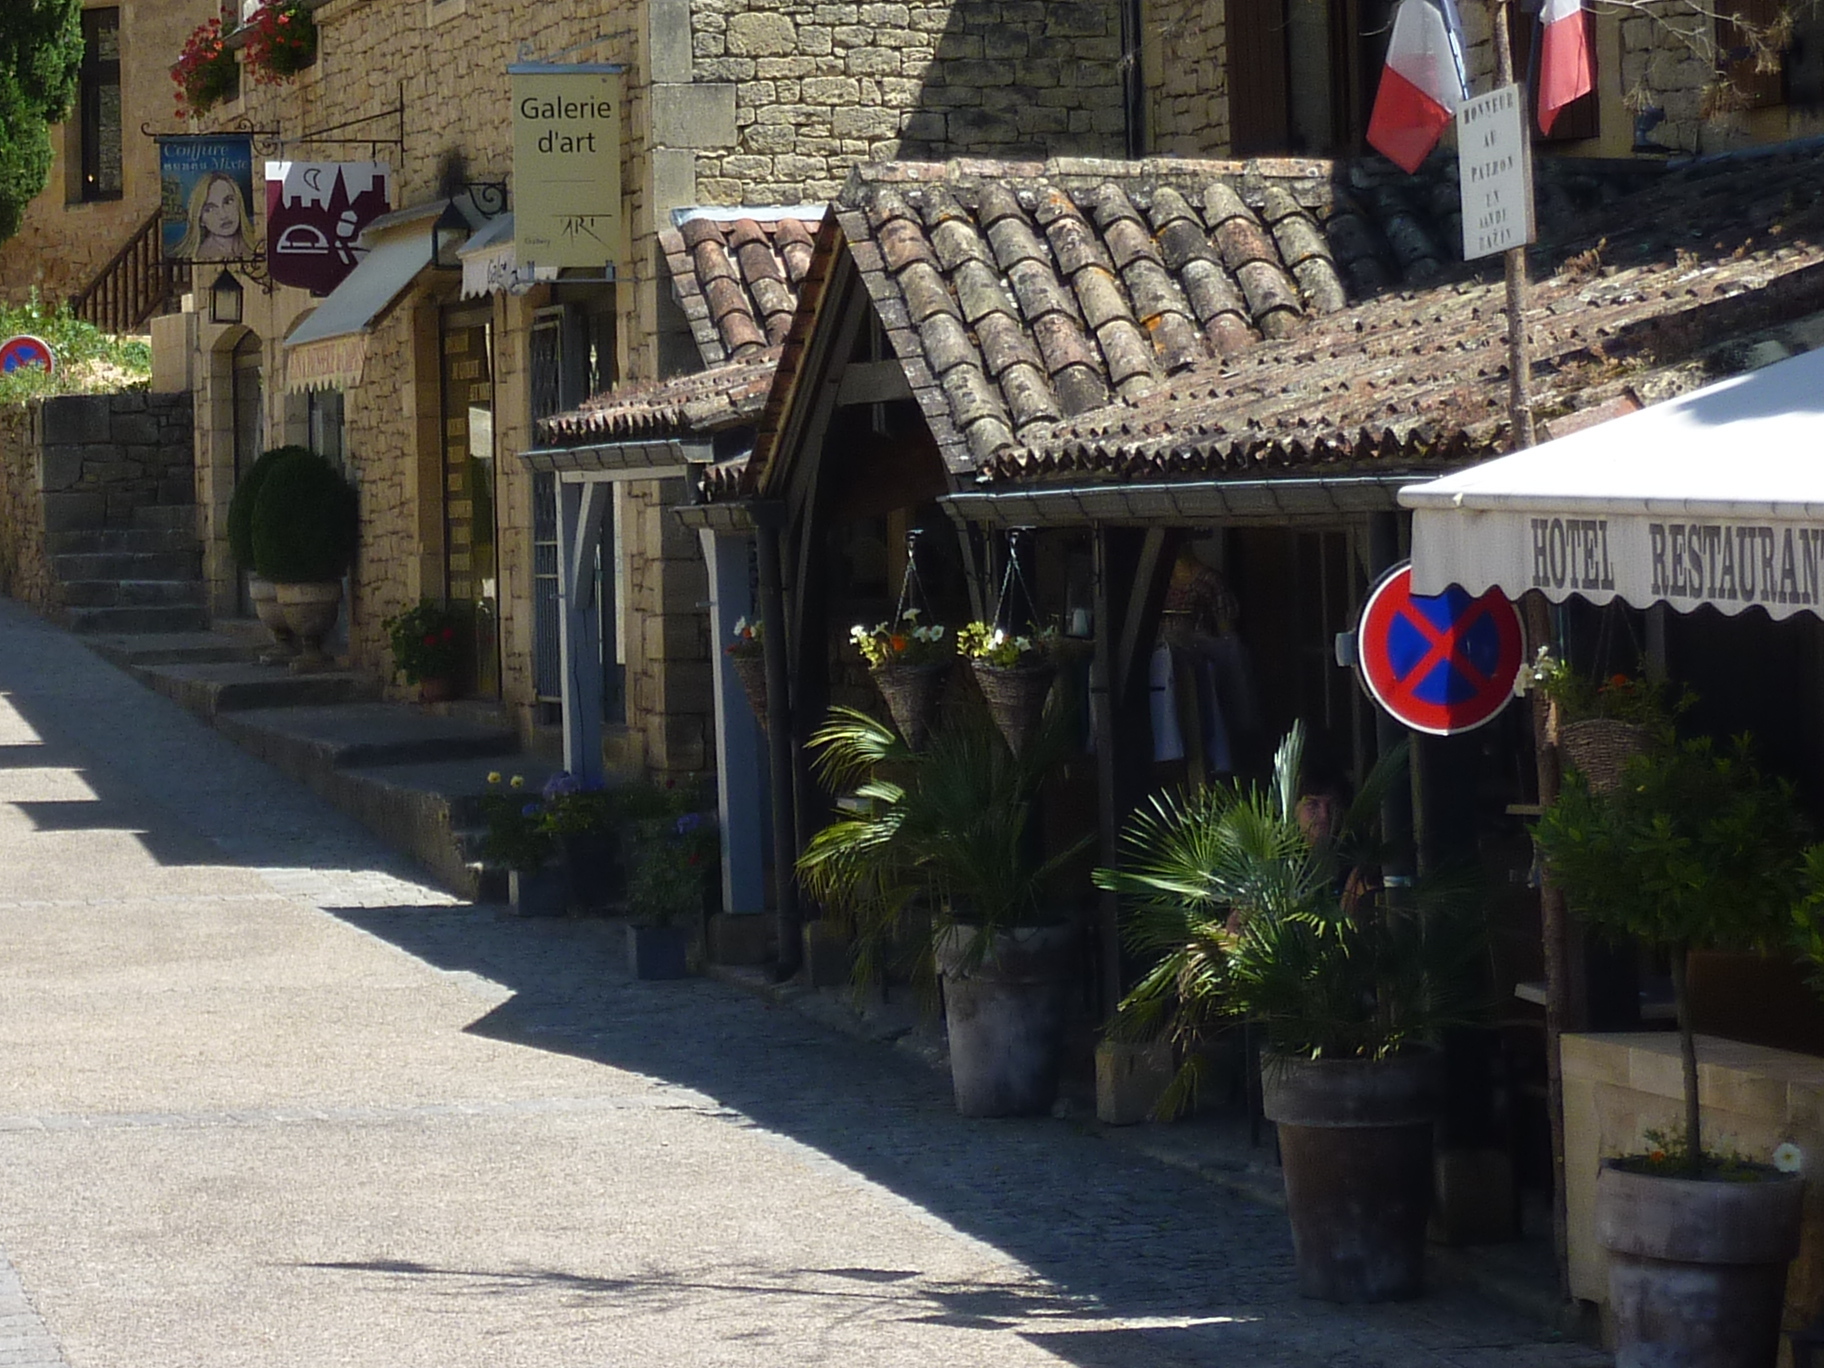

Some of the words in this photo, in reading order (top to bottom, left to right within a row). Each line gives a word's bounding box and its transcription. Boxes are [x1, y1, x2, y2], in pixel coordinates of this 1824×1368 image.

[520, 95, 612, 120] Galerie
[1463, 91, 1514, 125] HONNEUR
[537, 129, 597, 154] d'art
[1483, 130, 1496, 148] AU
[163, 143, 229, 161] Coiffure
[1471, 155, 1514, 183] PATRON
[1530, 518, 1616, 592] HOTEL
[1648, 522, 1824, 605] RESTAURAN
